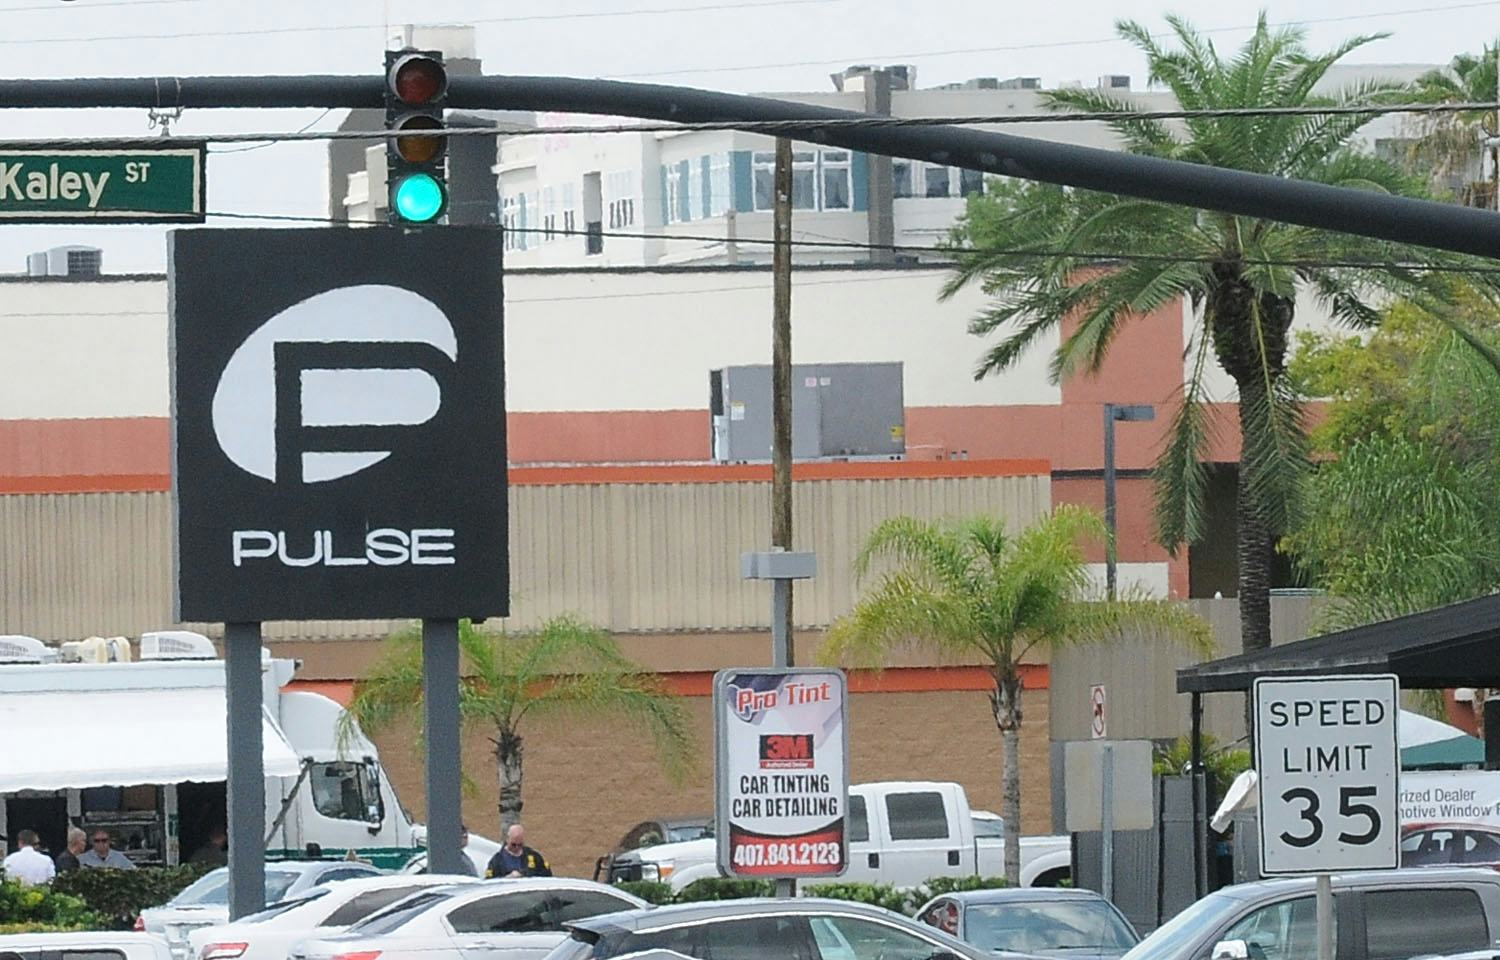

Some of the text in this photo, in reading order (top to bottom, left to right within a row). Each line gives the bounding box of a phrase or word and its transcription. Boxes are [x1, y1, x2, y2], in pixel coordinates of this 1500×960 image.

[0, 162, 150, 208] Kaley ST
[232, 528, 456, 567] PULSE
[737, 682, 831, 713] Pro Tint
[1269, 700, 1385, 727] SPEED
[766, 735, 810, 760] 3M
[1284, 745, 1372, 773] LIMIT
[740, 774, 830, 794] CAR TINTING
[1435, 788, 1476, 802] Dealer
[732, 797, 838, 818] CAR DETAILING
[1280, 786, 1382, 848] 35
[1440, 804, 1493, 818] Window
[734, 843, 841, 867] 407.841.2123
